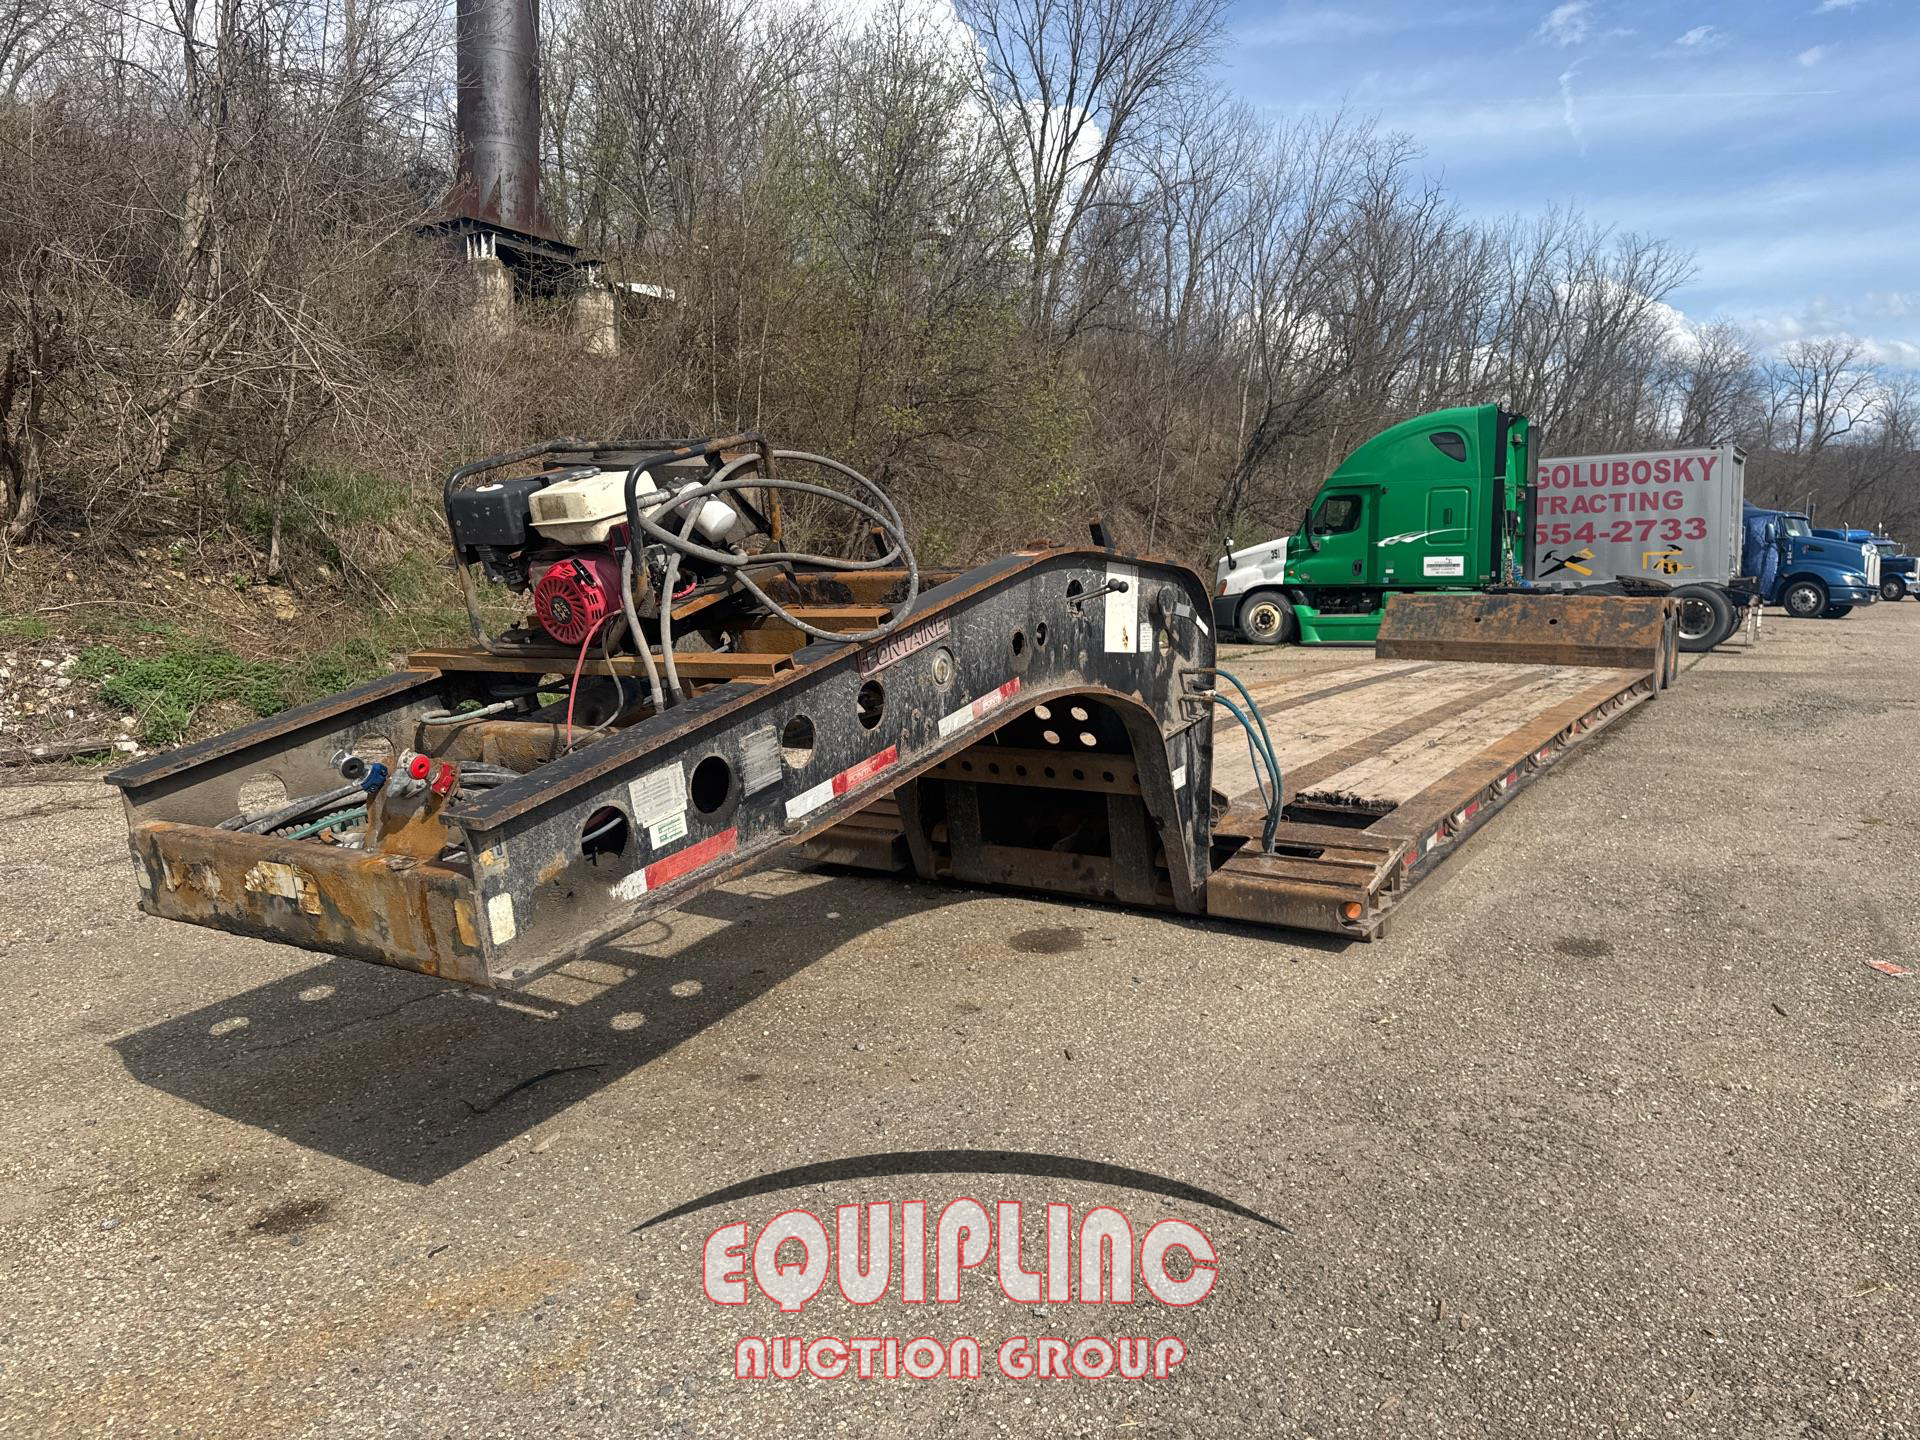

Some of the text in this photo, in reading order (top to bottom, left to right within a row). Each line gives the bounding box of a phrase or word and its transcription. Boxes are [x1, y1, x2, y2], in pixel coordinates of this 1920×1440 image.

[1536, 456, 1718, 490] GOLUBOSKY
[1536, 490, 1684, 516] TRACTING
[1535, 517, 1708, 545] 554-2733
[863, 613, 950, 672] FONTAINE
